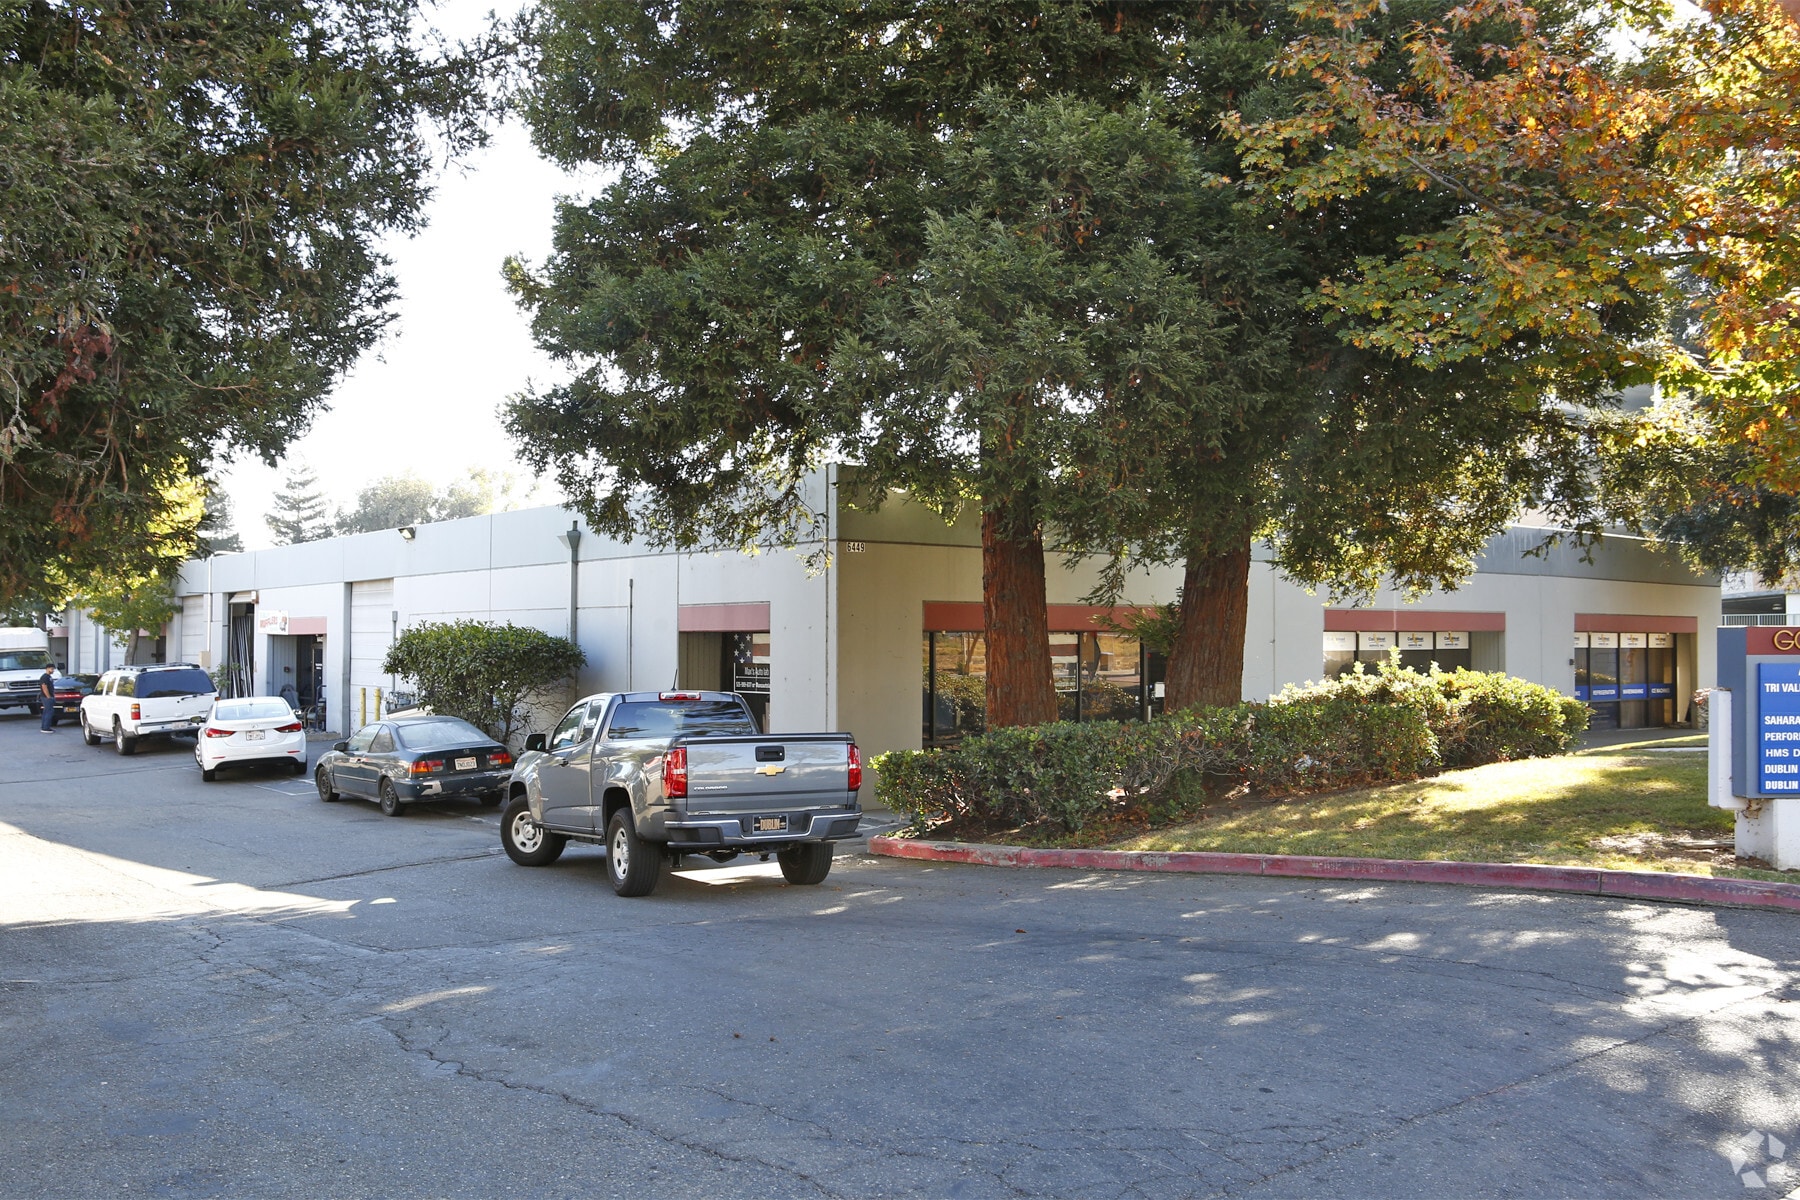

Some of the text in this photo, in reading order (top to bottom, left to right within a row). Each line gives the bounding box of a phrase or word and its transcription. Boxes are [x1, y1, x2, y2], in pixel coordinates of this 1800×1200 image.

[847, 542, 865, 552] 6449
[1764, 683, 1800, 692] TRI VAL
[1764, 715, 1800, 725] SAHARA
[1765, 732, 1800, 741] PERFOR
[1766, 748, 1790, 757] HMS
[1765, 764, 1798, 774] DUBLIN
[1765, 780, 1799, 790] DUBLIN
[760, 818, 781, 831] DUBLIN
